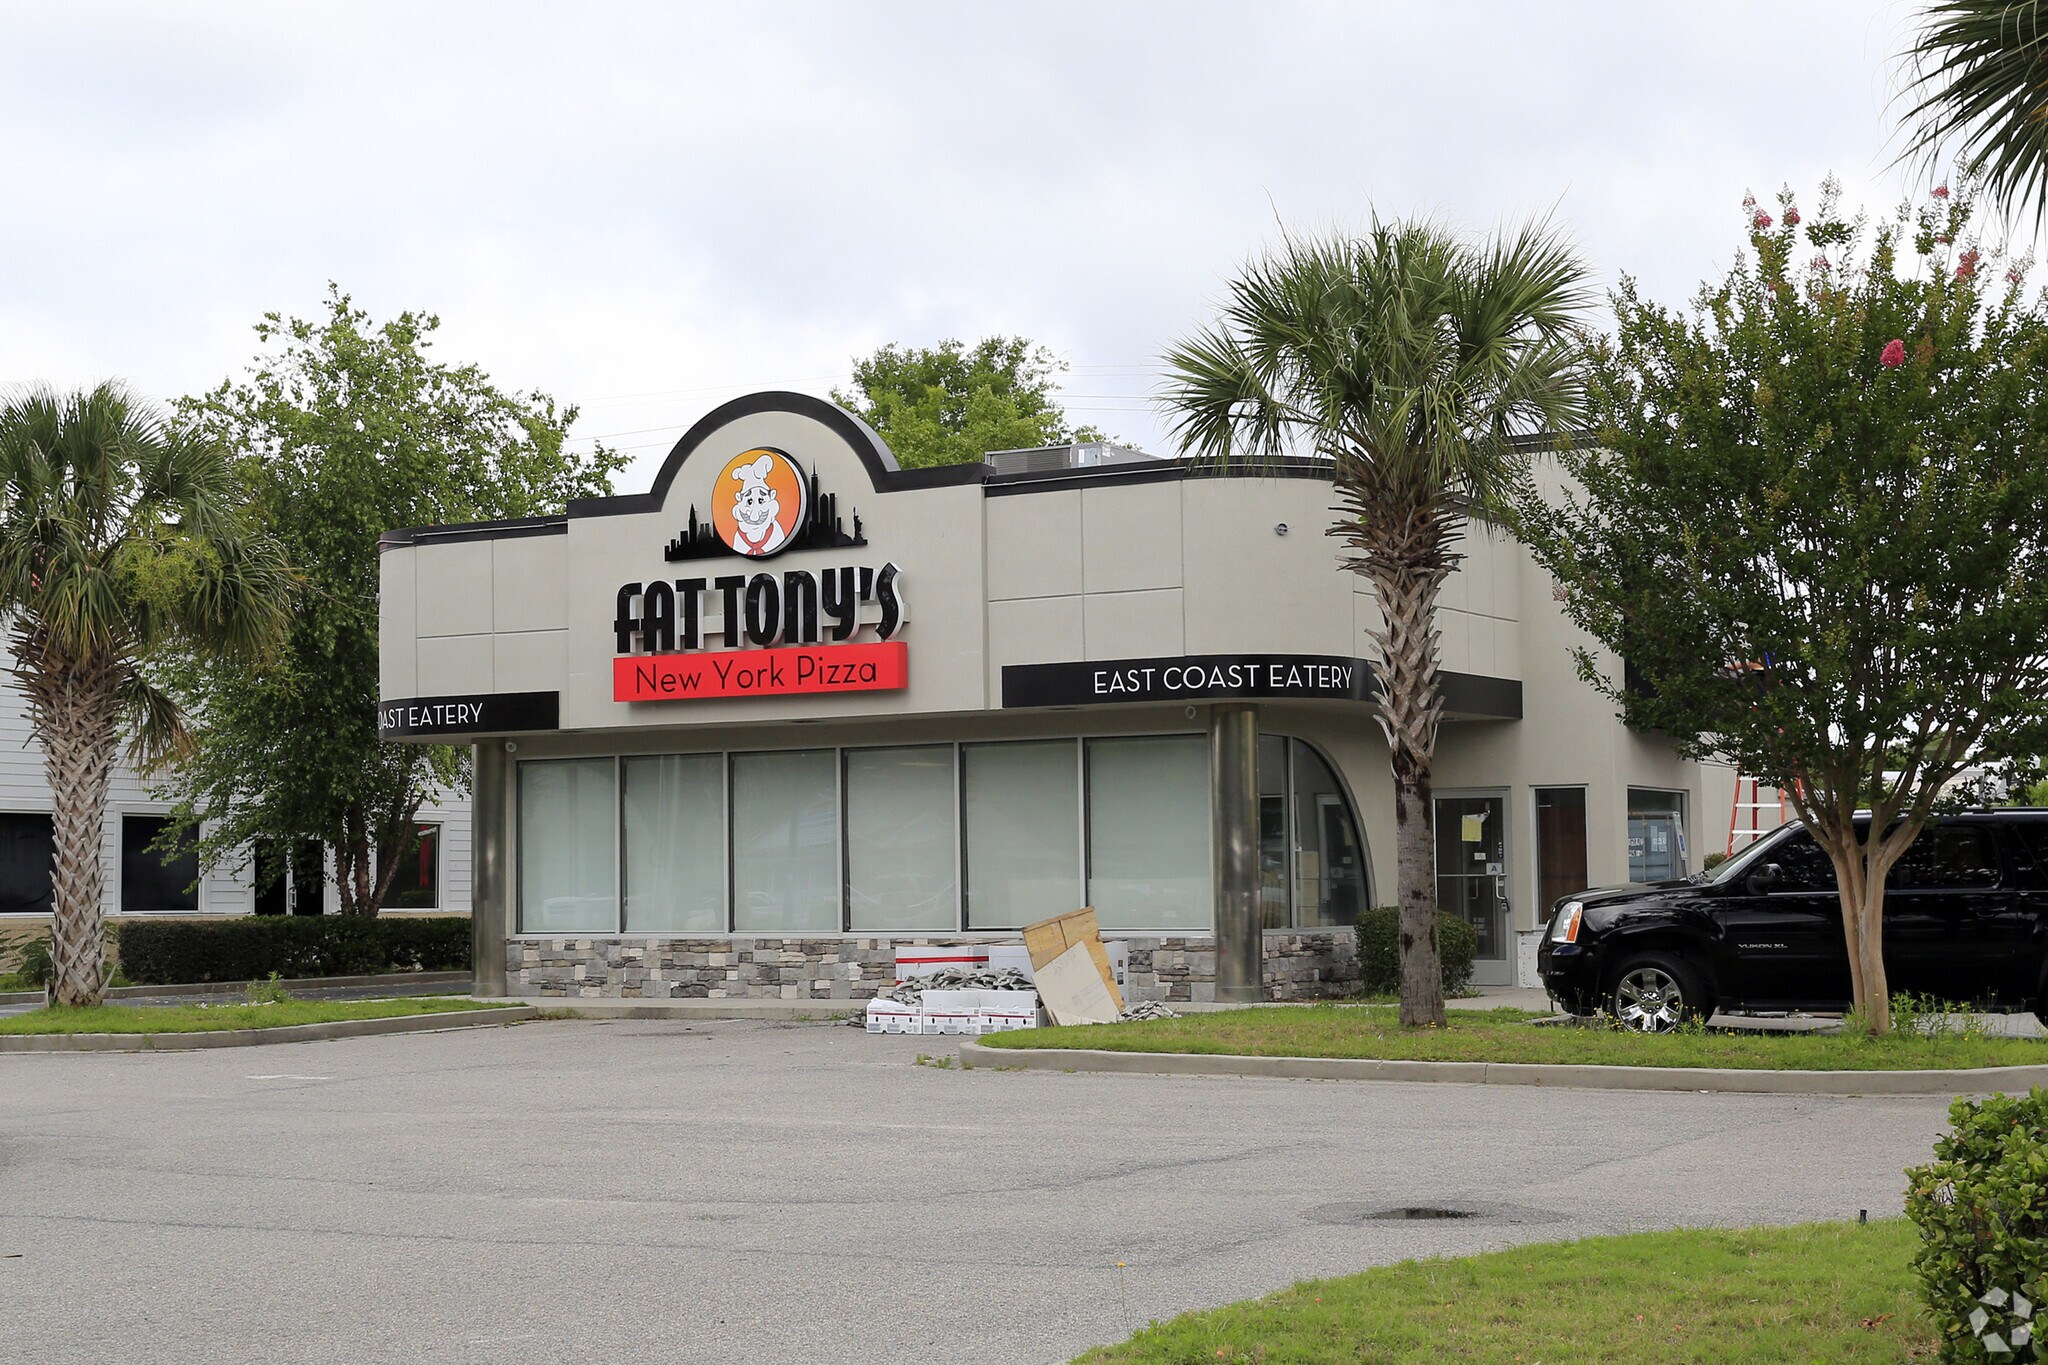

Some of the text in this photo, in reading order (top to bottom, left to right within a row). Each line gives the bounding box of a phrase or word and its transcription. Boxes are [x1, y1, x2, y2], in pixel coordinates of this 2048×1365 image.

[636, 655, 877, 694] New York Pizza
[1094, 665, 1353, 694] EAST COAST EATERY
[408, 702, 483, 727] EATERY
